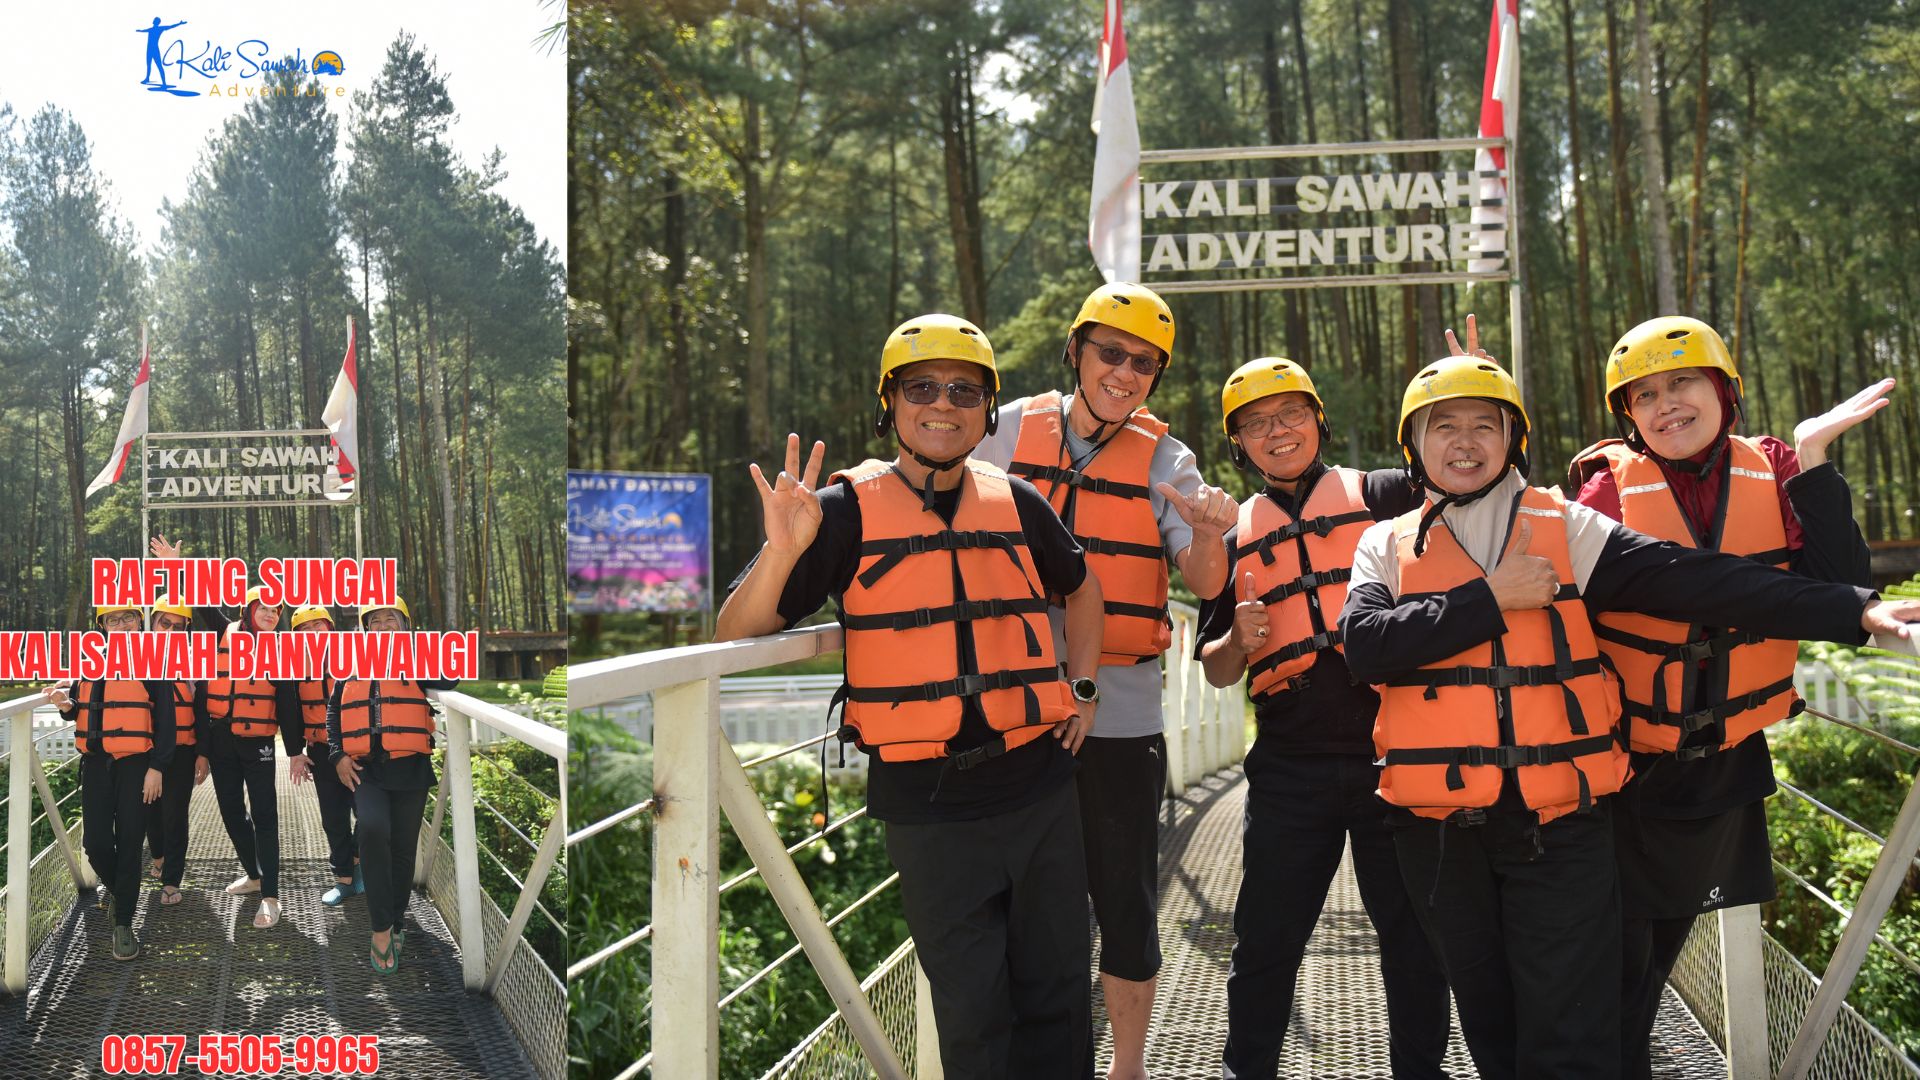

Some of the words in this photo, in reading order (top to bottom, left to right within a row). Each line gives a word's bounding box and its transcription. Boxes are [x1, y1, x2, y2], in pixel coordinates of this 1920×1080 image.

[1143, 178, 1270, 218] KALI
[1296, 171, 1481, 213] SAWAH
[1147, 224, 1482, 271] ADVENTURE
[159, 448, 227, 469] KALI
[241, 446, 340, 467] SAWAH
[161, 474, 341, 497] ADVENTURE
[624, 479, 697, 493] DATANG
